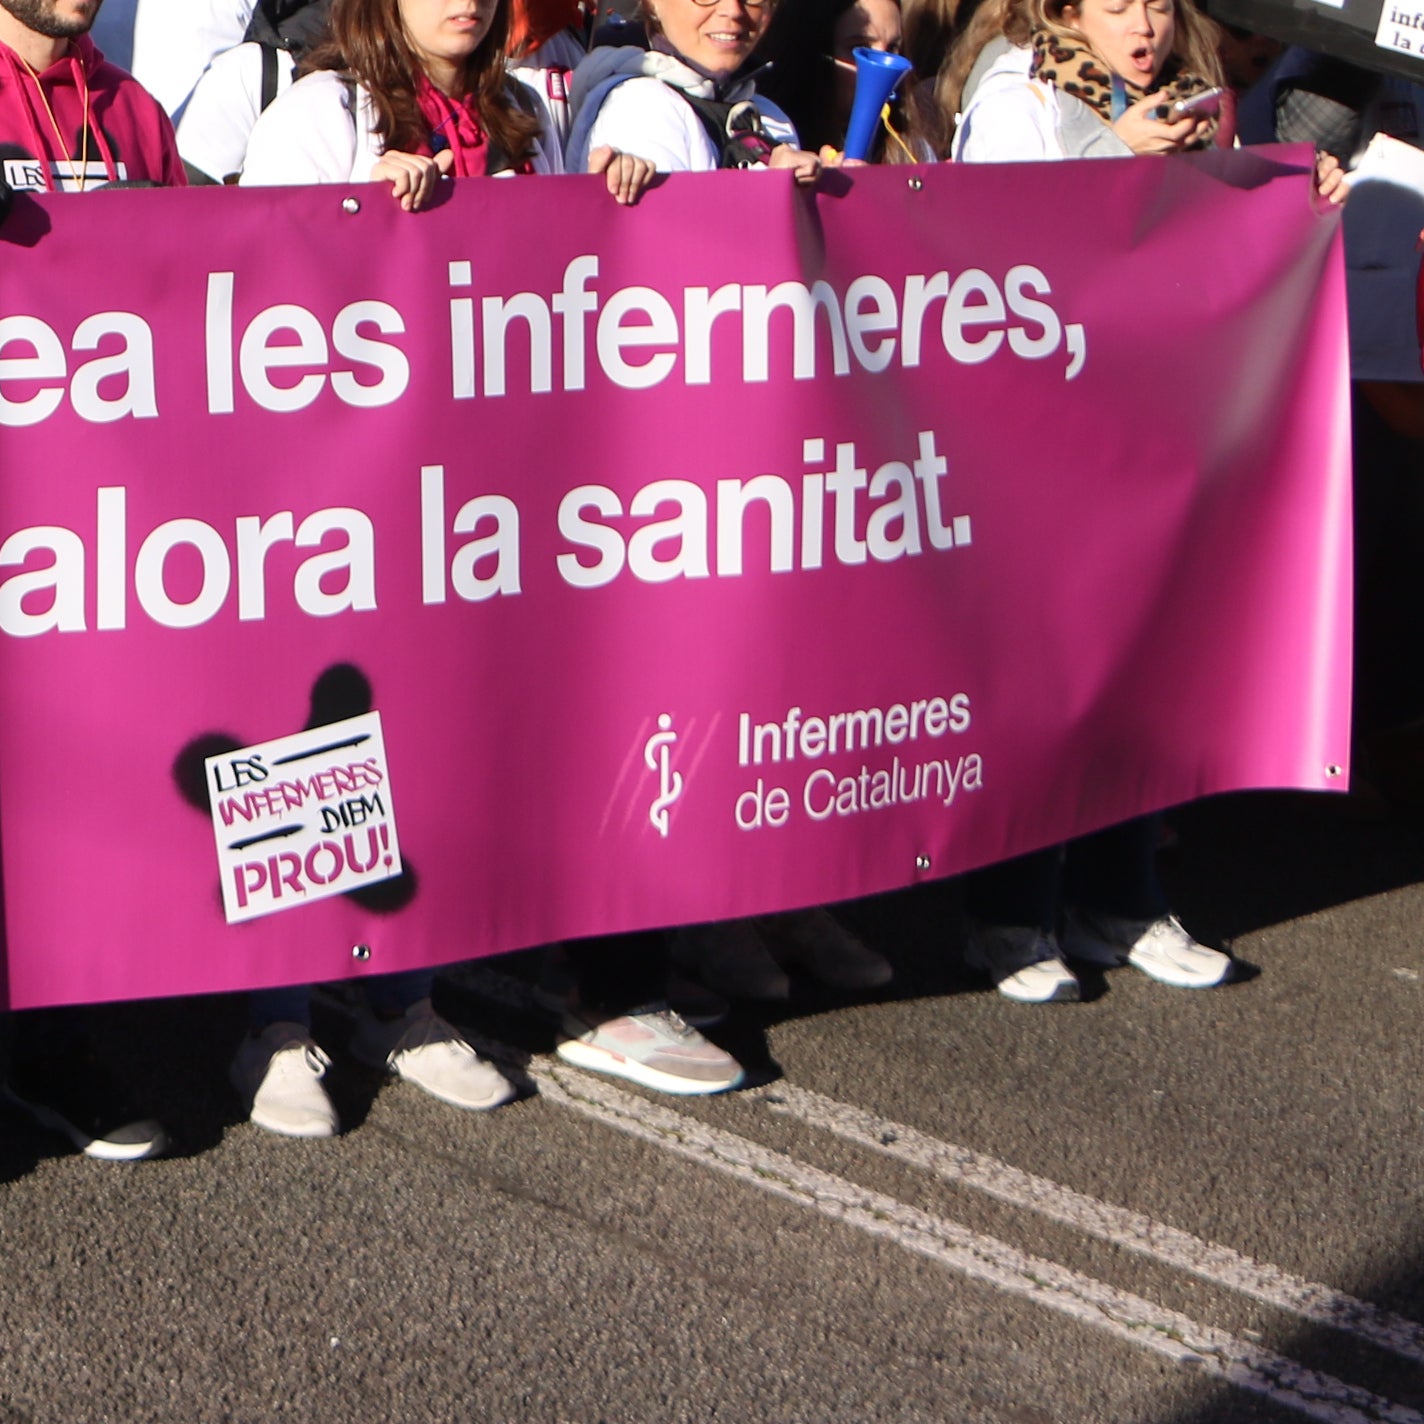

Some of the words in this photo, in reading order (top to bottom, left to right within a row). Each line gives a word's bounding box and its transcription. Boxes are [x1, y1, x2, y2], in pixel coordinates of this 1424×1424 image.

[1393, 31, 1412, 51] la
[205, 270, 409, 414] les
[449, 255, 1087, 399] infermeres,
[420, 465, 523, 605] la
[557, 430, 972, 589] sanitat.
[738, 693, 971, 764] Infermeres
[213, 754, 269, 793] LES
[218, 757, 384, 826] INFERMERES
[735, 777, 795, 830] de
[803, 748, 983, 822] Catalunya
[320, 791, 385, 834] DIEM
[232, 822, 394, 909] PROU!
